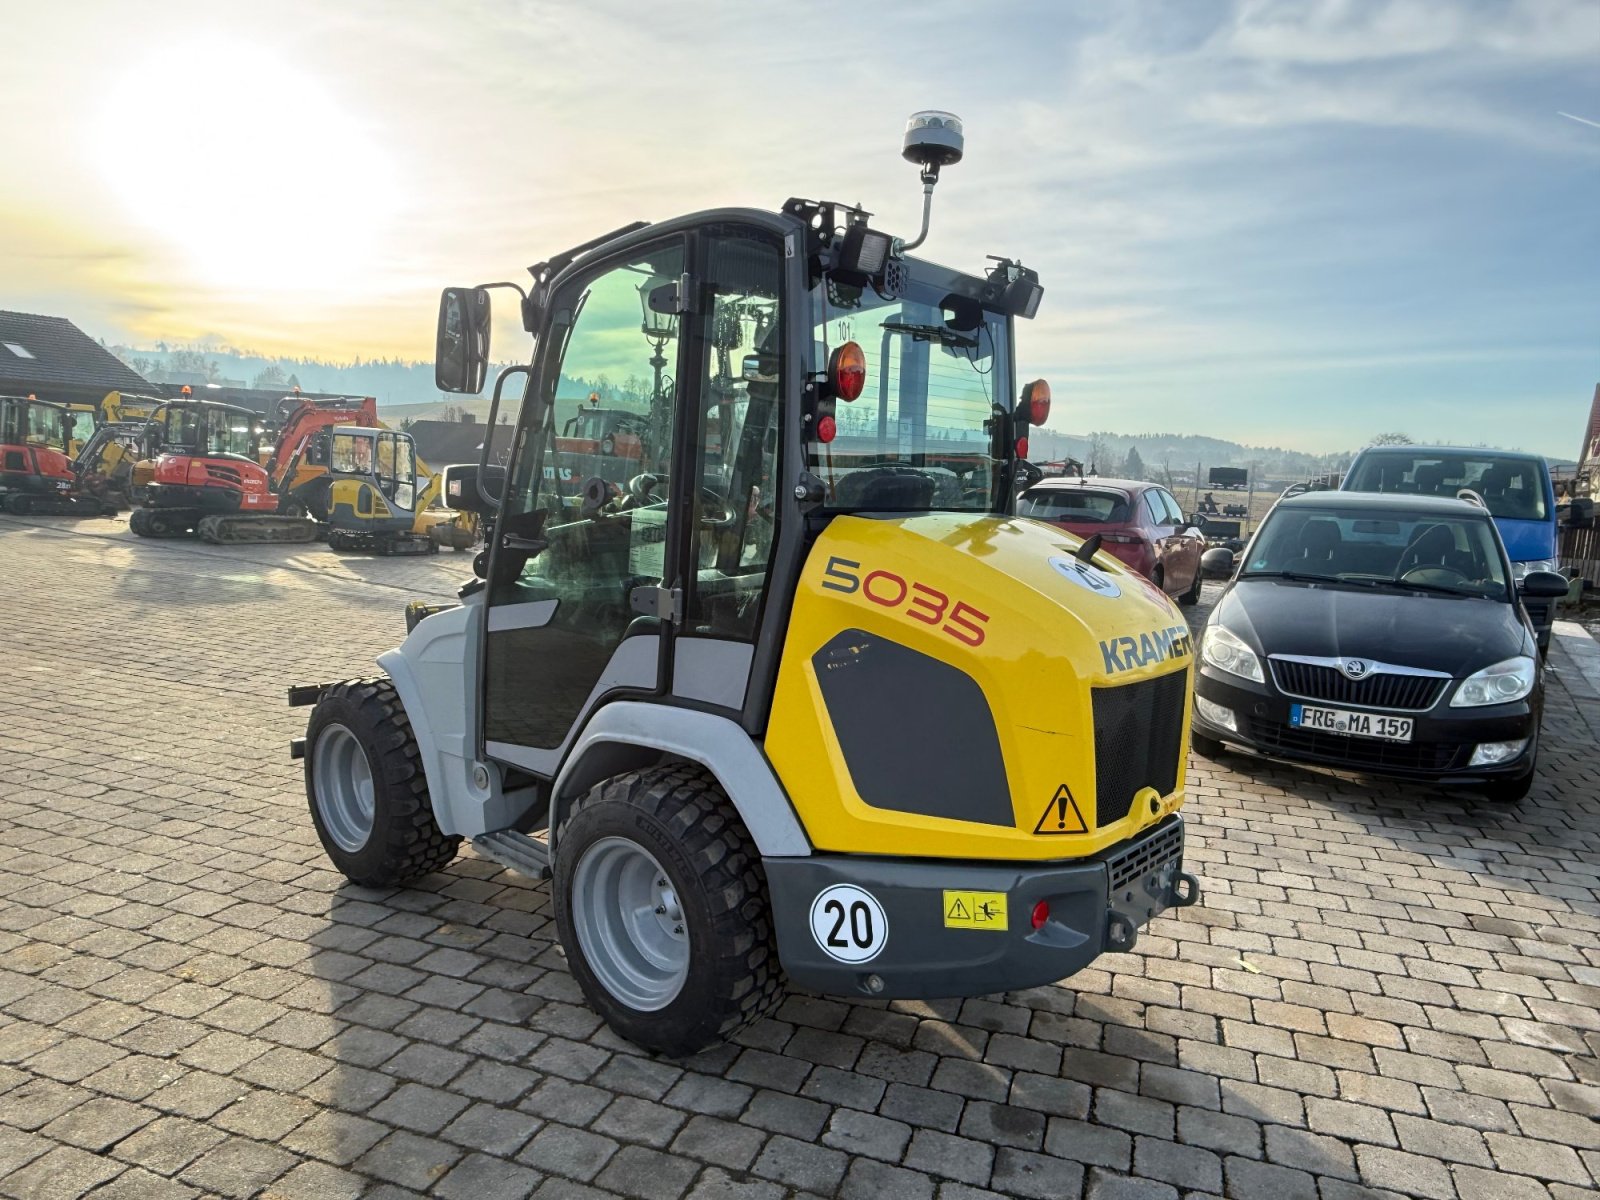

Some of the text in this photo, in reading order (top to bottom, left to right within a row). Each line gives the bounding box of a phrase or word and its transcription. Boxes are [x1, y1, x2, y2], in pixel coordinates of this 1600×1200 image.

[1058, 563, 1111, 590] 20
[821, 556, 990, 648] 5035
[1099, 625, 1193, 674] KRAMER
[1301, 707, 1336, 729] FRG
[1347, 713, 1371, 734] MA
[1375, 717, 1411, 738] 159
[823, 898, 874, 950] 20
